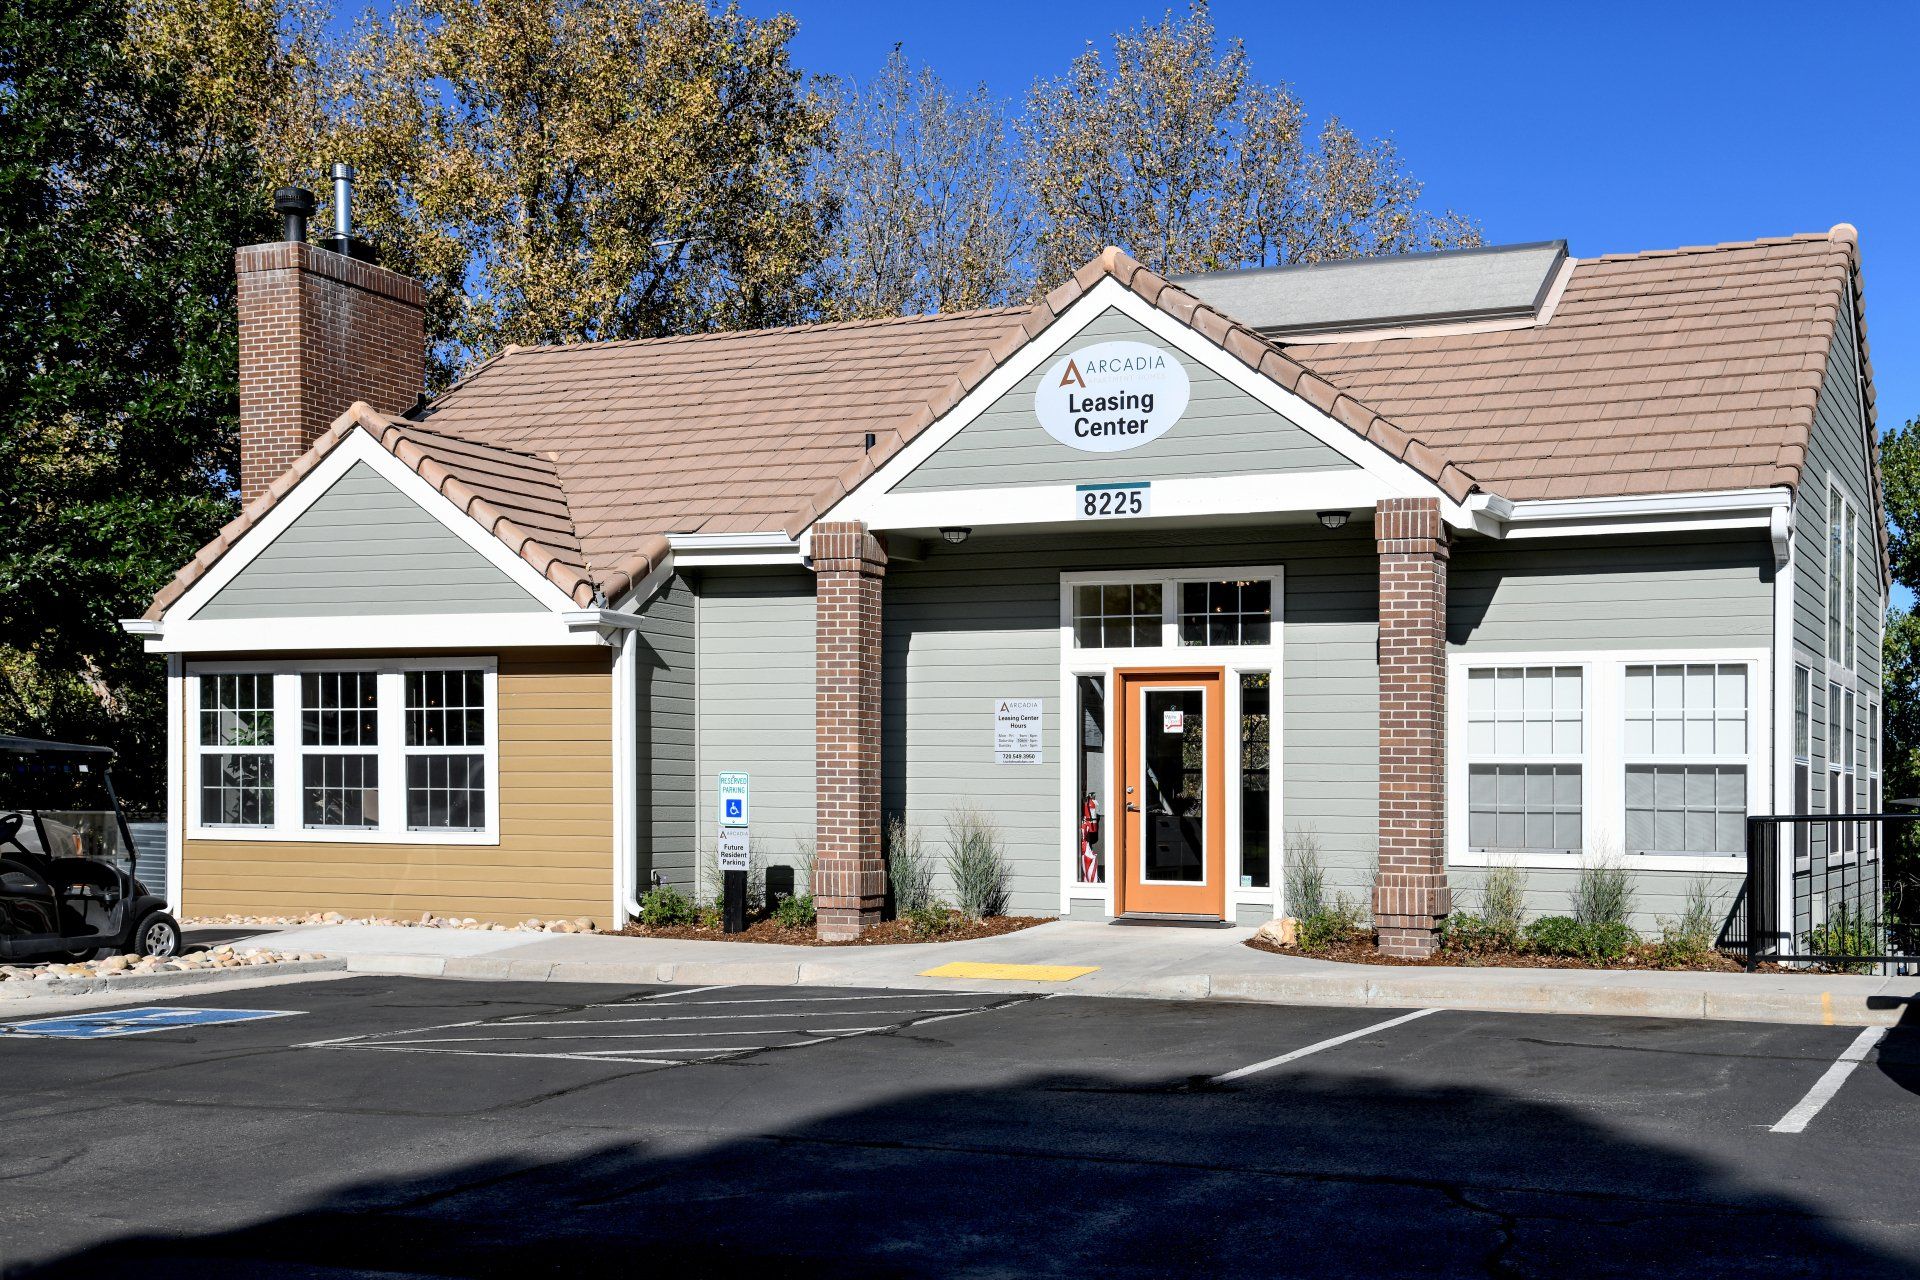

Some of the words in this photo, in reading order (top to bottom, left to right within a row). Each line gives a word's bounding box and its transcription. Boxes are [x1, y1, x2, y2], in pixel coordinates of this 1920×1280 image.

[1086, 355, 1166, 374] ARCADIA
[1069, 390, 1154, 413] Leasing
[1074, 417, 1149, 438] Center
[1084, 491, 1142, 516] 8225
[722, 859, 746, 867] Parking
